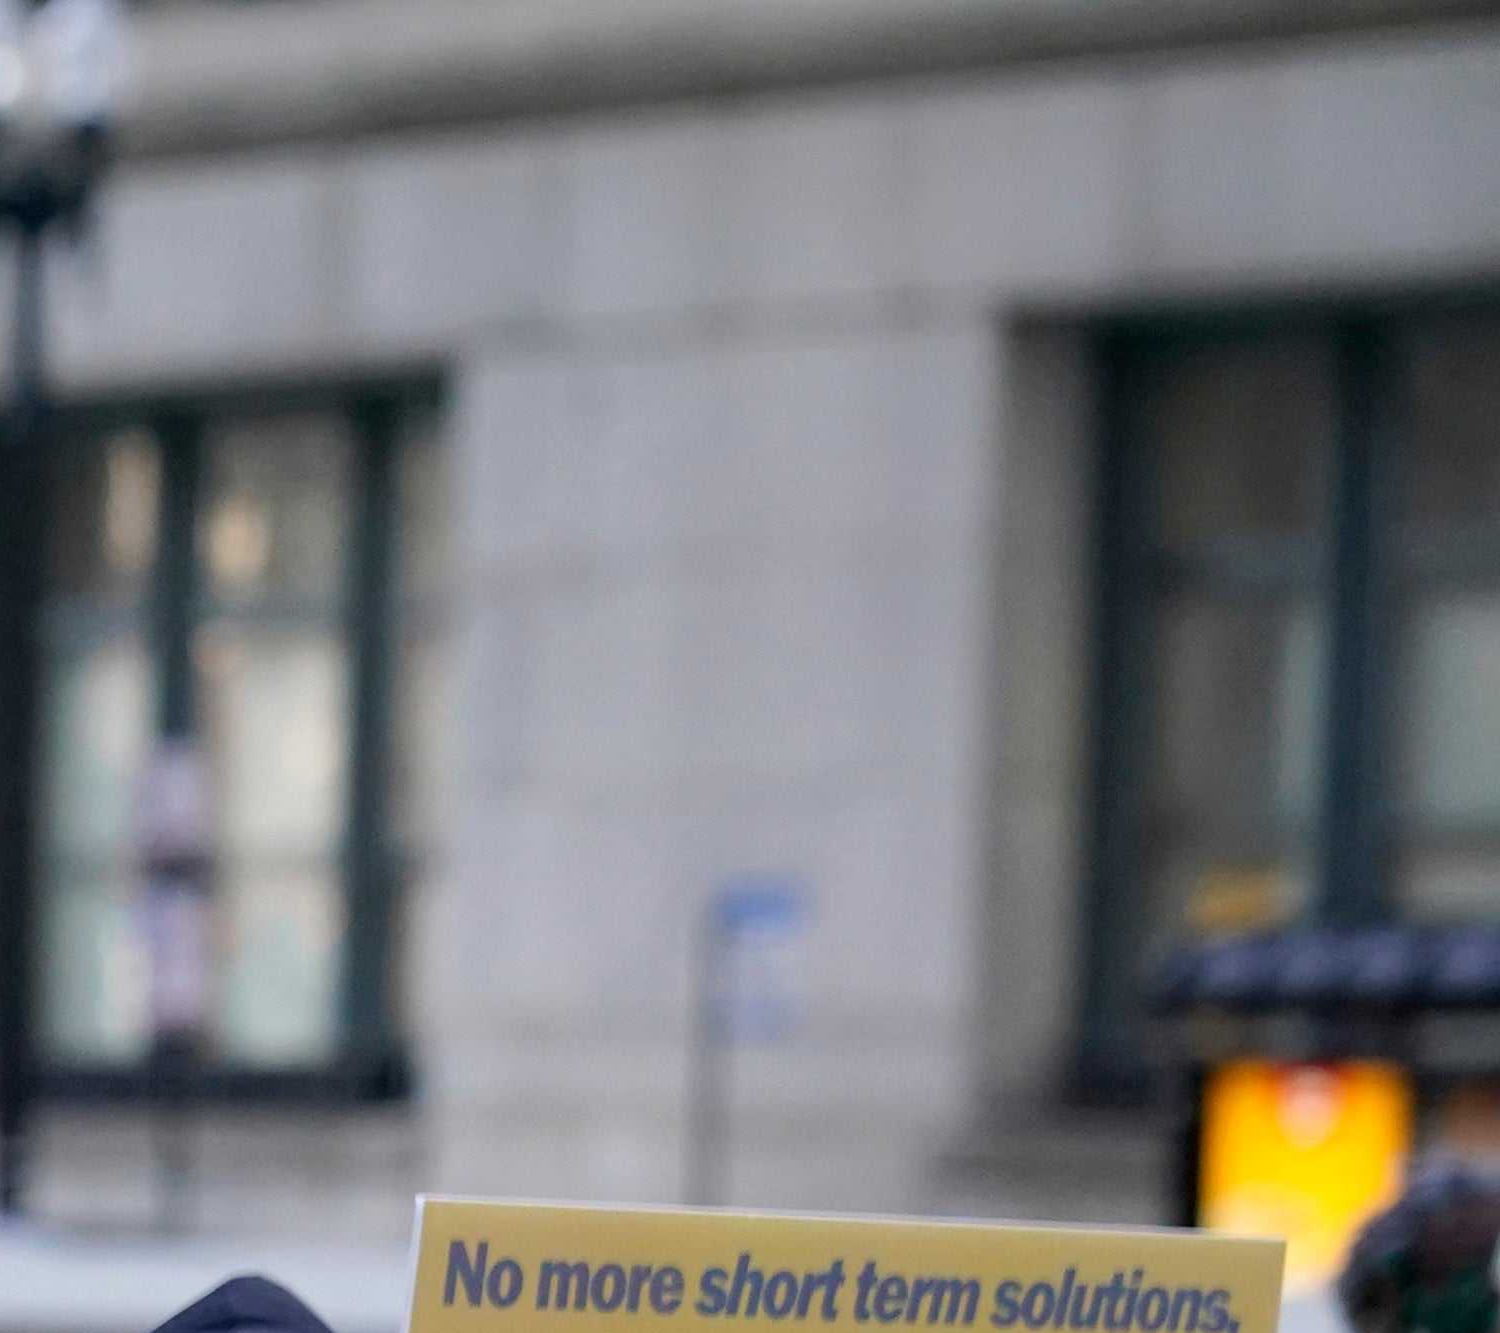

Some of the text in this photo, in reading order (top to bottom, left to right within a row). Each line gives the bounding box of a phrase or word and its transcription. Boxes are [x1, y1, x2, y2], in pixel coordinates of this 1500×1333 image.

[443, 1239, 523, 1309] No
[536, 1259, 685, 1315] more
[696, 1251, 845, 1322] short
[853, 1261, 981, 1326] term
